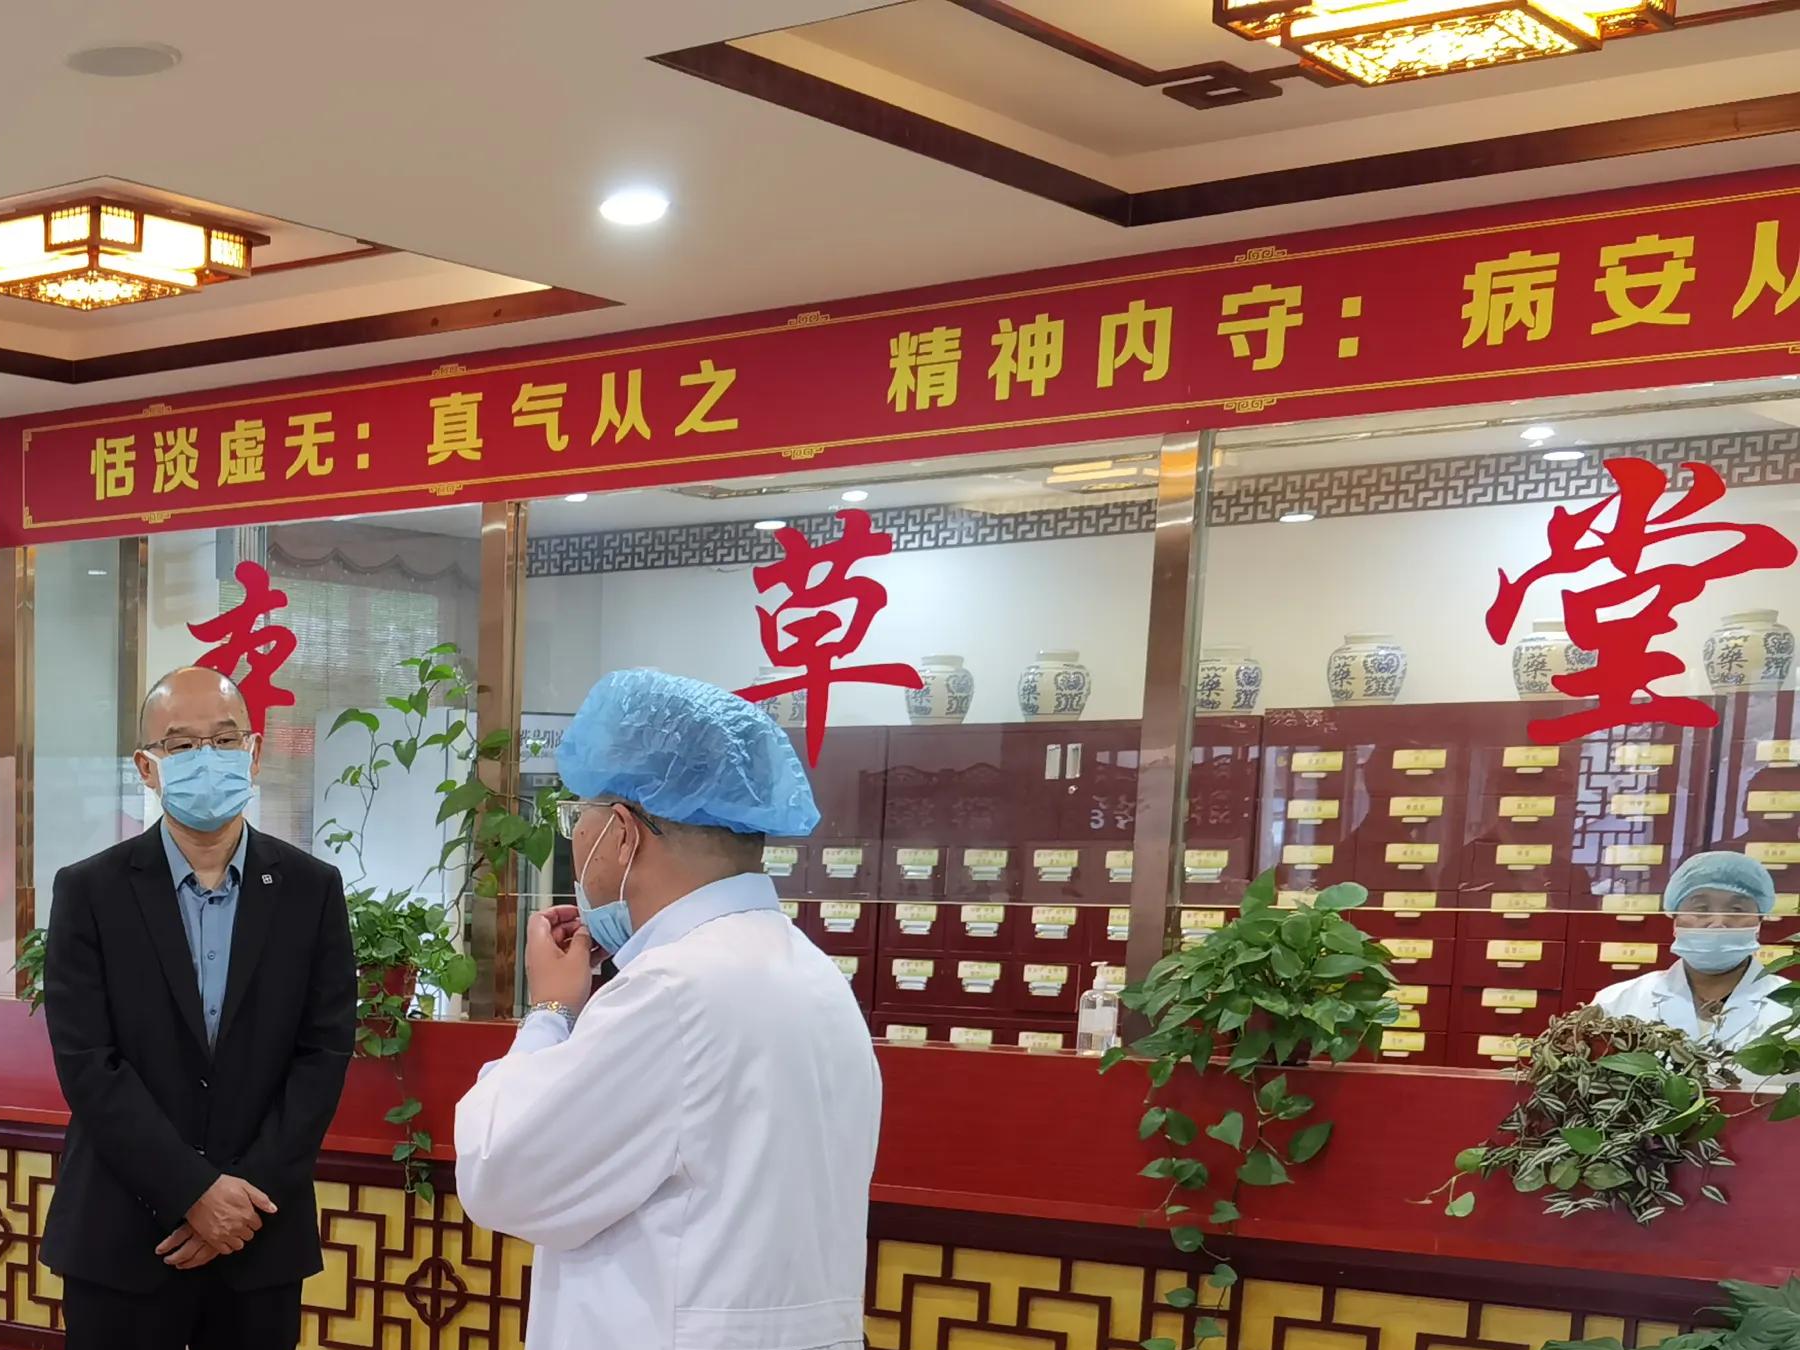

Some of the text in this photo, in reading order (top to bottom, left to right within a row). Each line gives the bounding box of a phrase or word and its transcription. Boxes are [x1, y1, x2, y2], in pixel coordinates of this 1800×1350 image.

[89, 358, 741, 501] 恬淡虚无：真气从之
[1485, 456, 1800, 746] 堂
